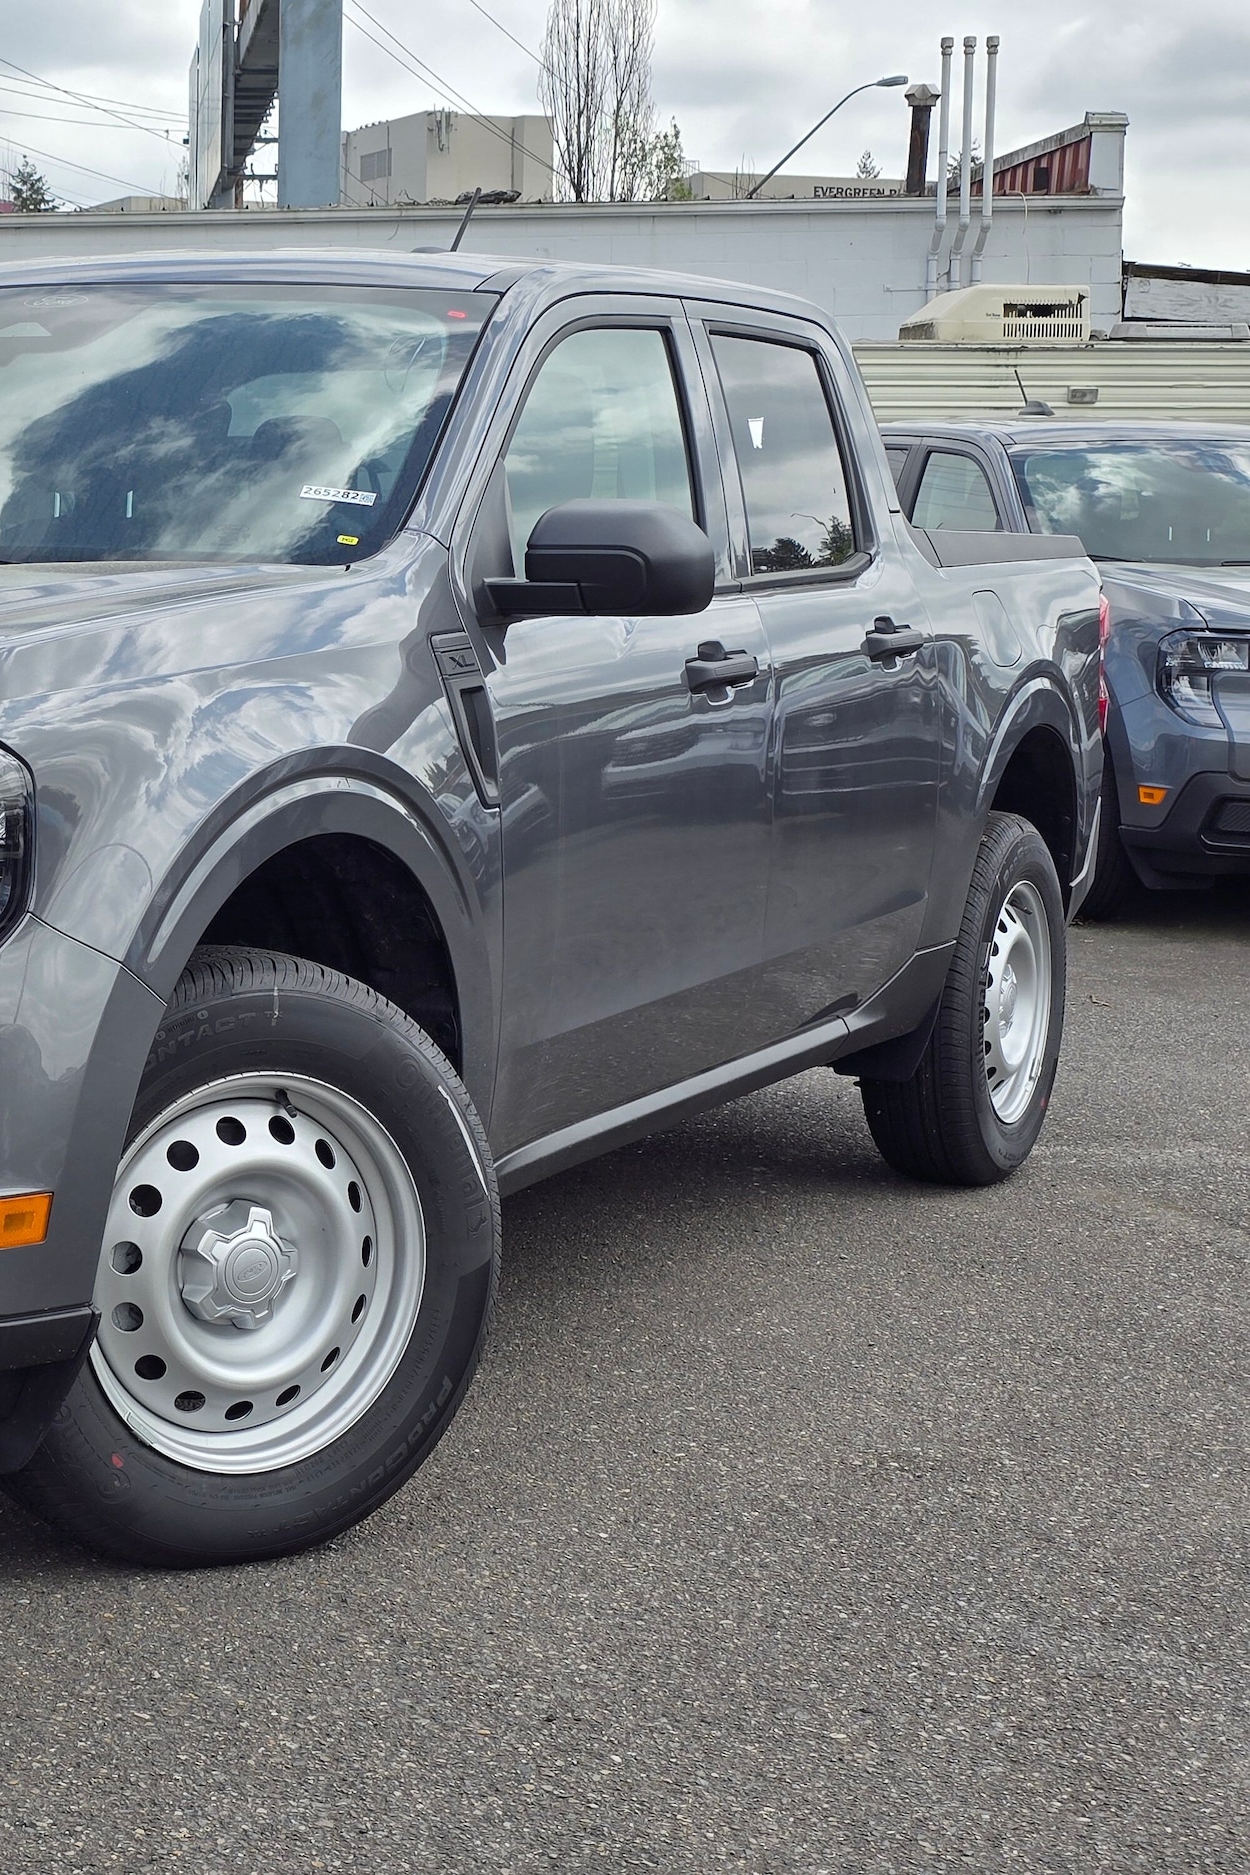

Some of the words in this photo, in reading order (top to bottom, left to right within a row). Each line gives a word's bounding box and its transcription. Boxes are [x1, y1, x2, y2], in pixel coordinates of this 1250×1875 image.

[813, 186, 885, 197] EVERGREEN
[303, 486, 360, 500] 265282
[449, 654, 475, 670] XL
